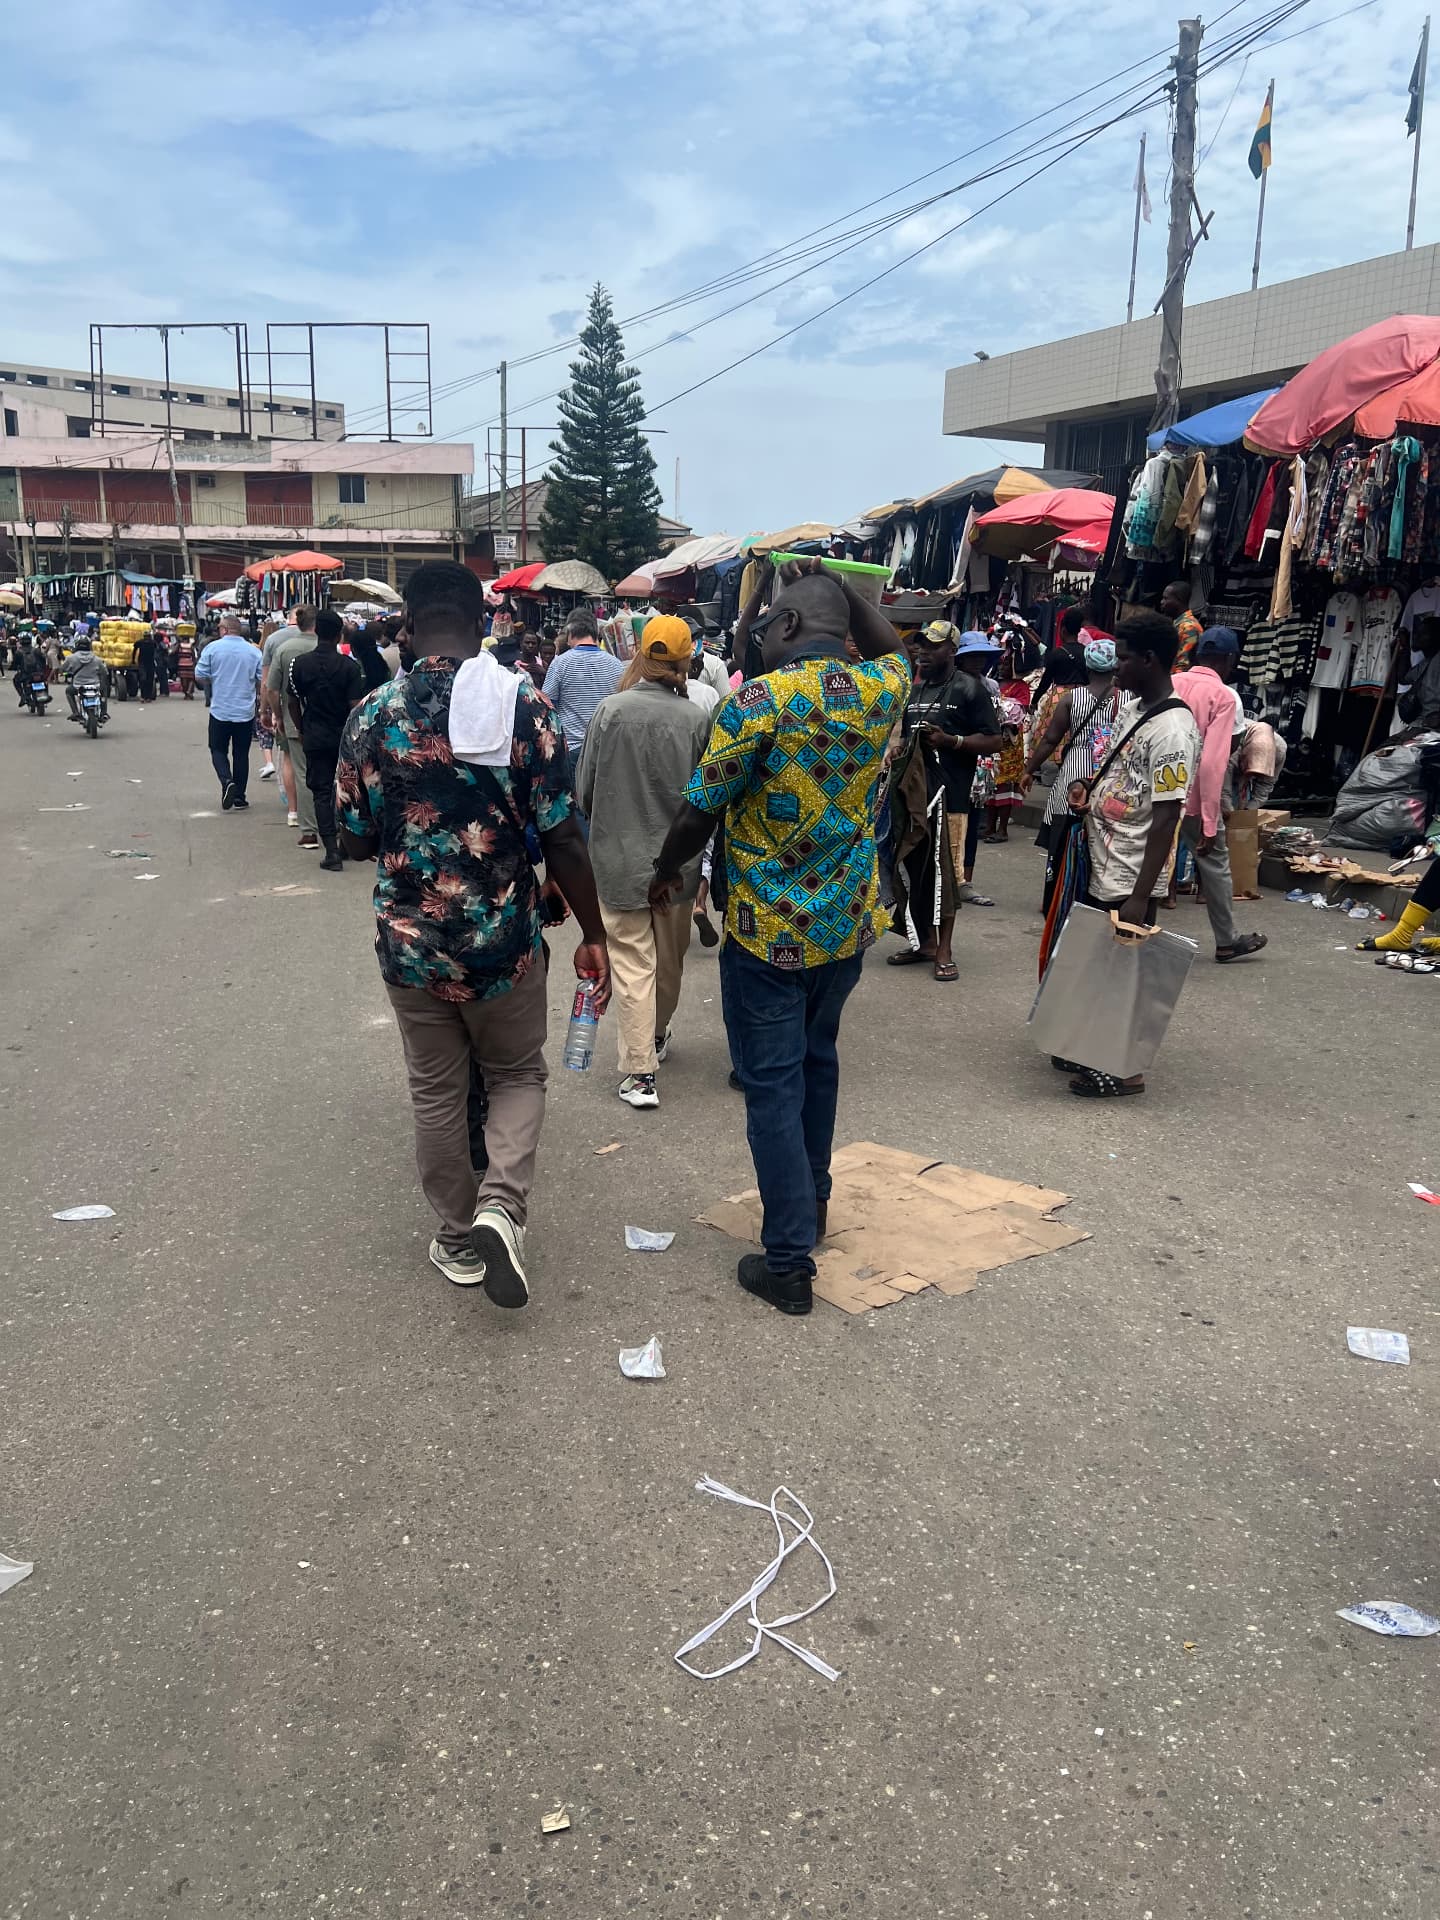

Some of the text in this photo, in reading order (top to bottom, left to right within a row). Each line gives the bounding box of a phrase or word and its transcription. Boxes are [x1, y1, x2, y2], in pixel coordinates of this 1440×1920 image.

[796, 700, 806, 712] 6
[802, 750, 812, 768] 2
[832, 748, 840, 764] 3
[860, 746, 870, 758] 4
[818, 826, 827, 838] B
[776, 878, 786, 888] M
